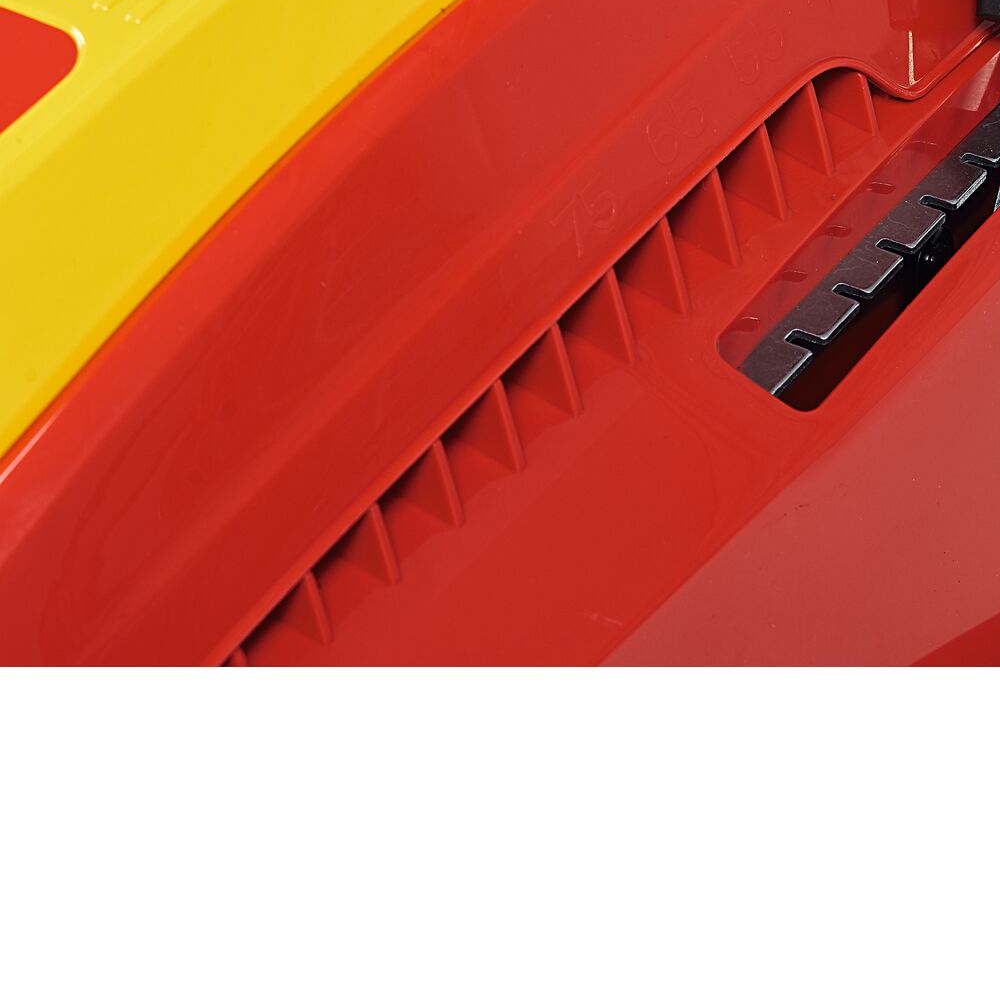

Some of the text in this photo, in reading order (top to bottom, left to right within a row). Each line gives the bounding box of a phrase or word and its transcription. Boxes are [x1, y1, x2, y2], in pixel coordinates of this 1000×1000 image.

[725, 15, 784, 86] 55
[645, 88, 706, 165] 65
[551, 172, 617, 258] 75
